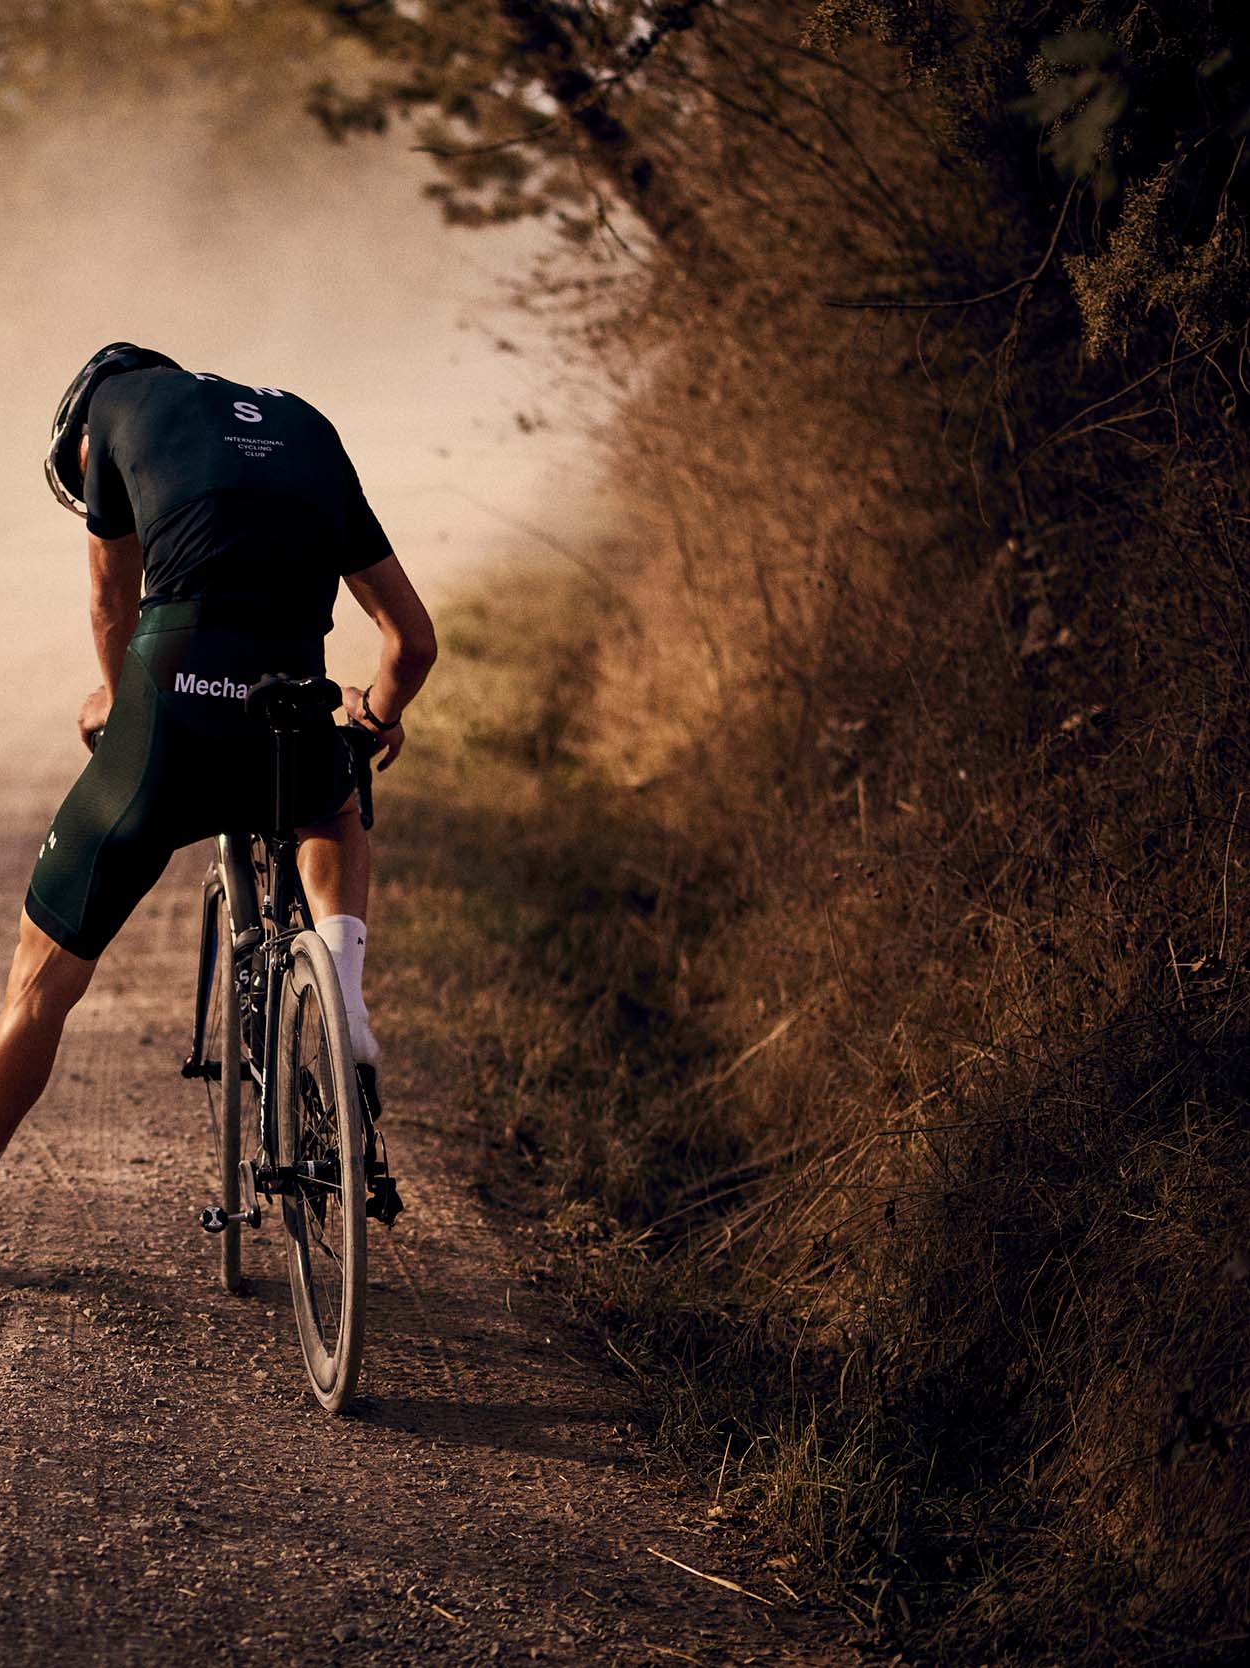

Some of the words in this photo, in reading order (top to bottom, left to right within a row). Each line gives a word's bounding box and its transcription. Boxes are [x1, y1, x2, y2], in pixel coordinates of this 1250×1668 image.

[233, 401, 263, 423] S
[224, 435, 285, 446] INTERNATIONAL
[237, 443, 272, 452] CYCLING
[174, 672, 253, 699] Mecha
